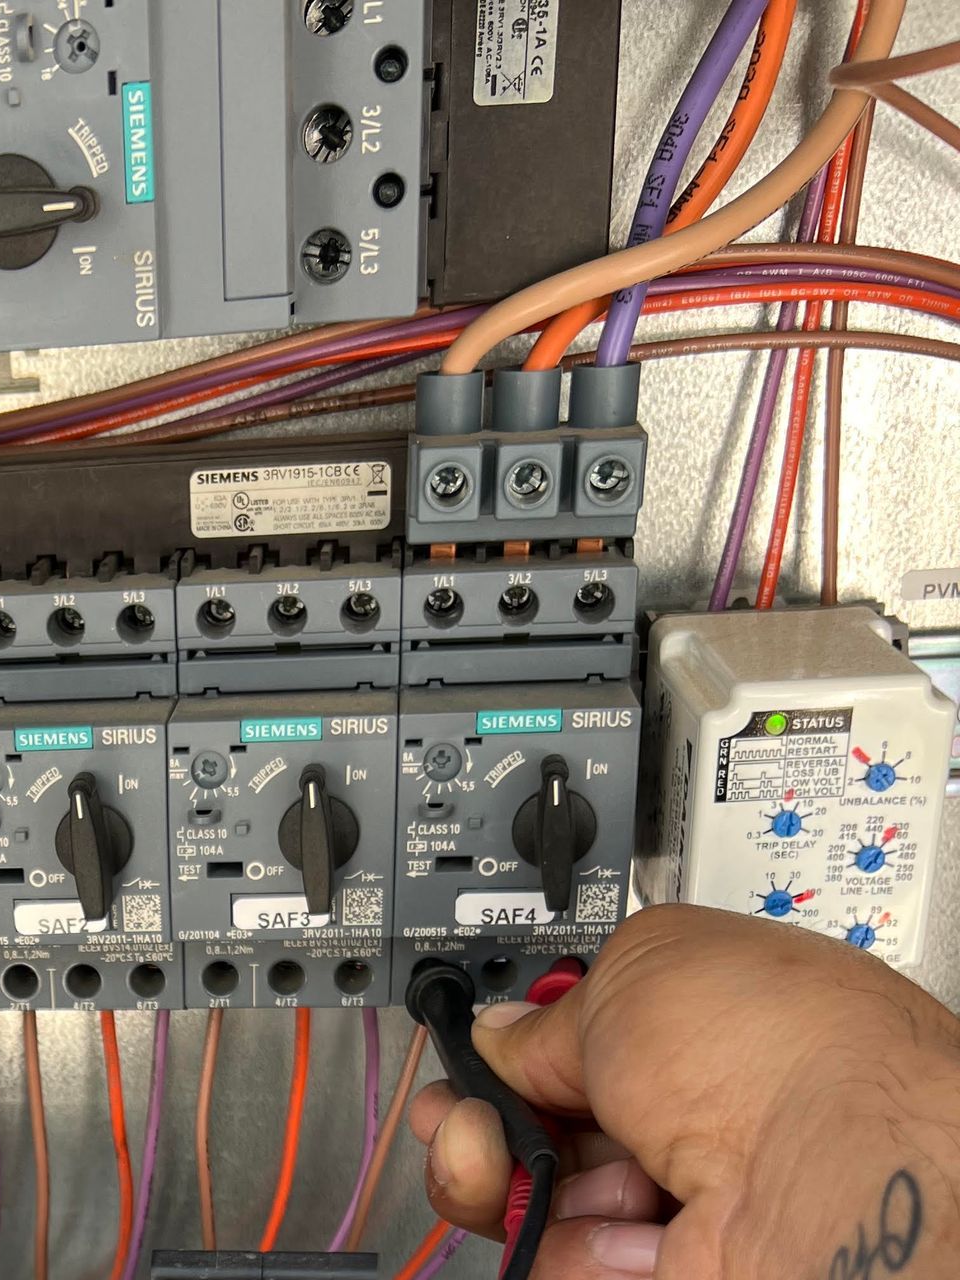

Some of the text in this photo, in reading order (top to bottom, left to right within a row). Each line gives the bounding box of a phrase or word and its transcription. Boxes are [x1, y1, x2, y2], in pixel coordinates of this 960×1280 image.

[0, 66, 11, 82] 10
[360, 105, 381, 155] 3/L2
[74, 118, 109, 175] TRIPPED
[128, 90, 147, 197] SIEMENS
[359, 228, 379, 276] 5/L3
[80, 256, 91, 275] ON
[134, 251, 154, 328] SIRIUS
[197, 465, 342, 485] SIEMENS 3RV1915-1CB
[433, 575, 455, 588] 1/L1
[508, 573, 532, 585] 3/L2
[583, 570, 607, 582] 5/L3
[205, 586, 227, 598] 1/L1
[277, 583, 299, 595] 3/L2
[349, 580, 372, 592] 5/L3
[54, 595, 76, 606] 3/L2
[123, 592, 145, 604] 5/L3
[482, 714, 557, 729] SIEMENS
[572, 710, 632, 728] SIRIUS
[792, 717, 844, 730] STATUS
[245, 722, 318, 738] SIEMENS
[330, 718, 388, 735] SIRIUS
[19, 732, 88, 747] SIEMENS
[102, 729, 157, 745] SIRIUS
[788, 737, 835, 746] NORMAL
[787, 746, 838, 756] RESTART
[484, 750, 523, 785] TRIPPED
[593, 763, 608, 775] ON
[786, 758, 845, 769] REVERSAL
[248, 757, 285, 789] TRIPPED
[352, 769, 367, 781] ON
[786, 767, 839, 778] LOSS UB
[25, 767, 60, 799] TRIPPED
[124, 779, 139, 790] ON
[785, 777, 840, 787] LOW VOLT
[813, 787, 841, 796] VOLT
[840, 796, 907, 806] UNBALANCE
[186, 828, 228, 840] CLASS 10
[418, 823, 461, 835] CLASS 10
[0, 837, 9, 848] 10
[430, 841, 456, 852] 104A
[756, 840, 816, 850] TRIP DELAY
[199, 846, 224, 856] 104A
[770, 851, 799, 860] (SEC)
[178, 865, 202, 876] TEST
[266, 865, 285, 876] OFF
[407, 860, 431, 871] TEST
[499, 861, 518, 872] OFF
[48, 873, 65, 884] OFF
[846, 877, 891, 886] VOLTAGE
[841, 887, 893, 895] LINE LINE
[257, 911, 311, 928] SAF3
[481, 907, 537, 924] SAF4
[38, 918, 89, 934] SAF2
[178, 930, 220, 940] G/201104
[302, 928, 382, 939] 3RV2011-1HA10
[403, 927, 447, 938] G/200515
[86, 934, 162, 945] 3RV2011-1HA10
